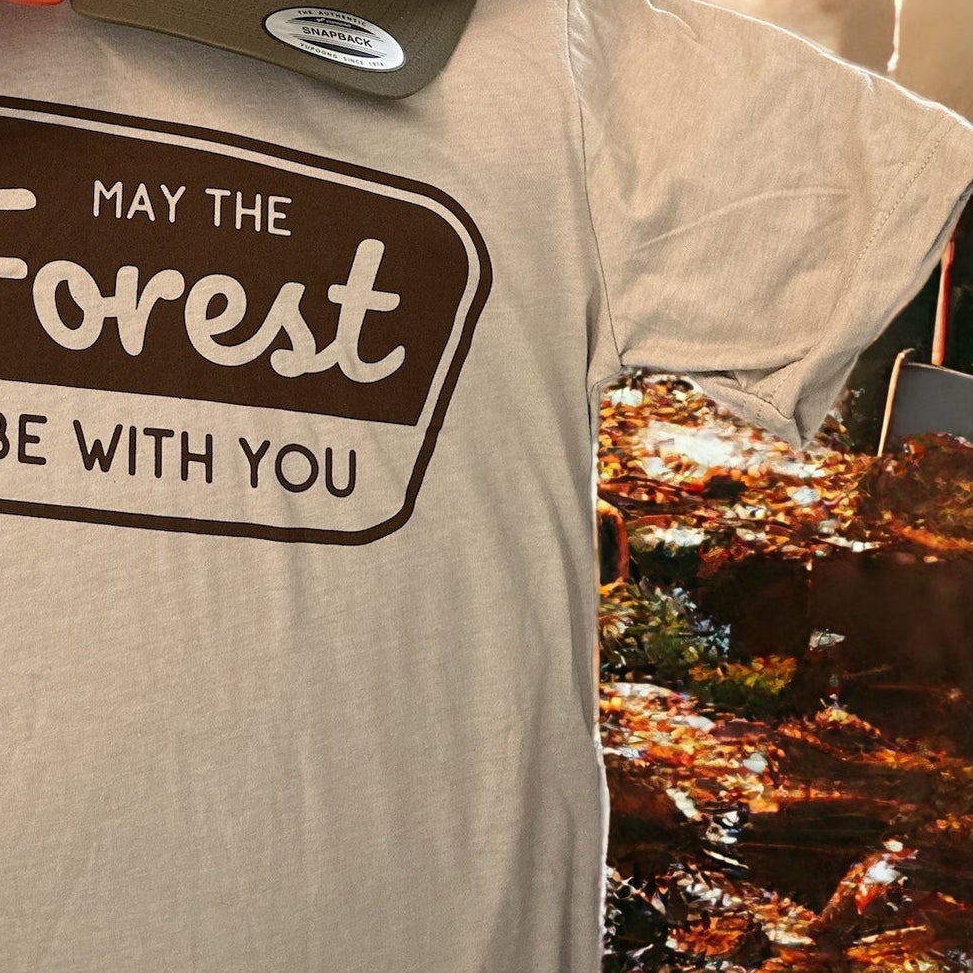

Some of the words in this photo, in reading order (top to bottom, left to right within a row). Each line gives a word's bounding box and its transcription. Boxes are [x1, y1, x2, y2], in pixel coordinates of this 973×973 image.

[302, 26, 373, 48] SNAPBACK
[318, 10, 368, 27] AUTHENTIC
[92, 179, 186, 224] MAY
[205, 187, 292, 236] THE
[73, 418, 213, 484] WITH
[238, 436, 357, 498] YOU
